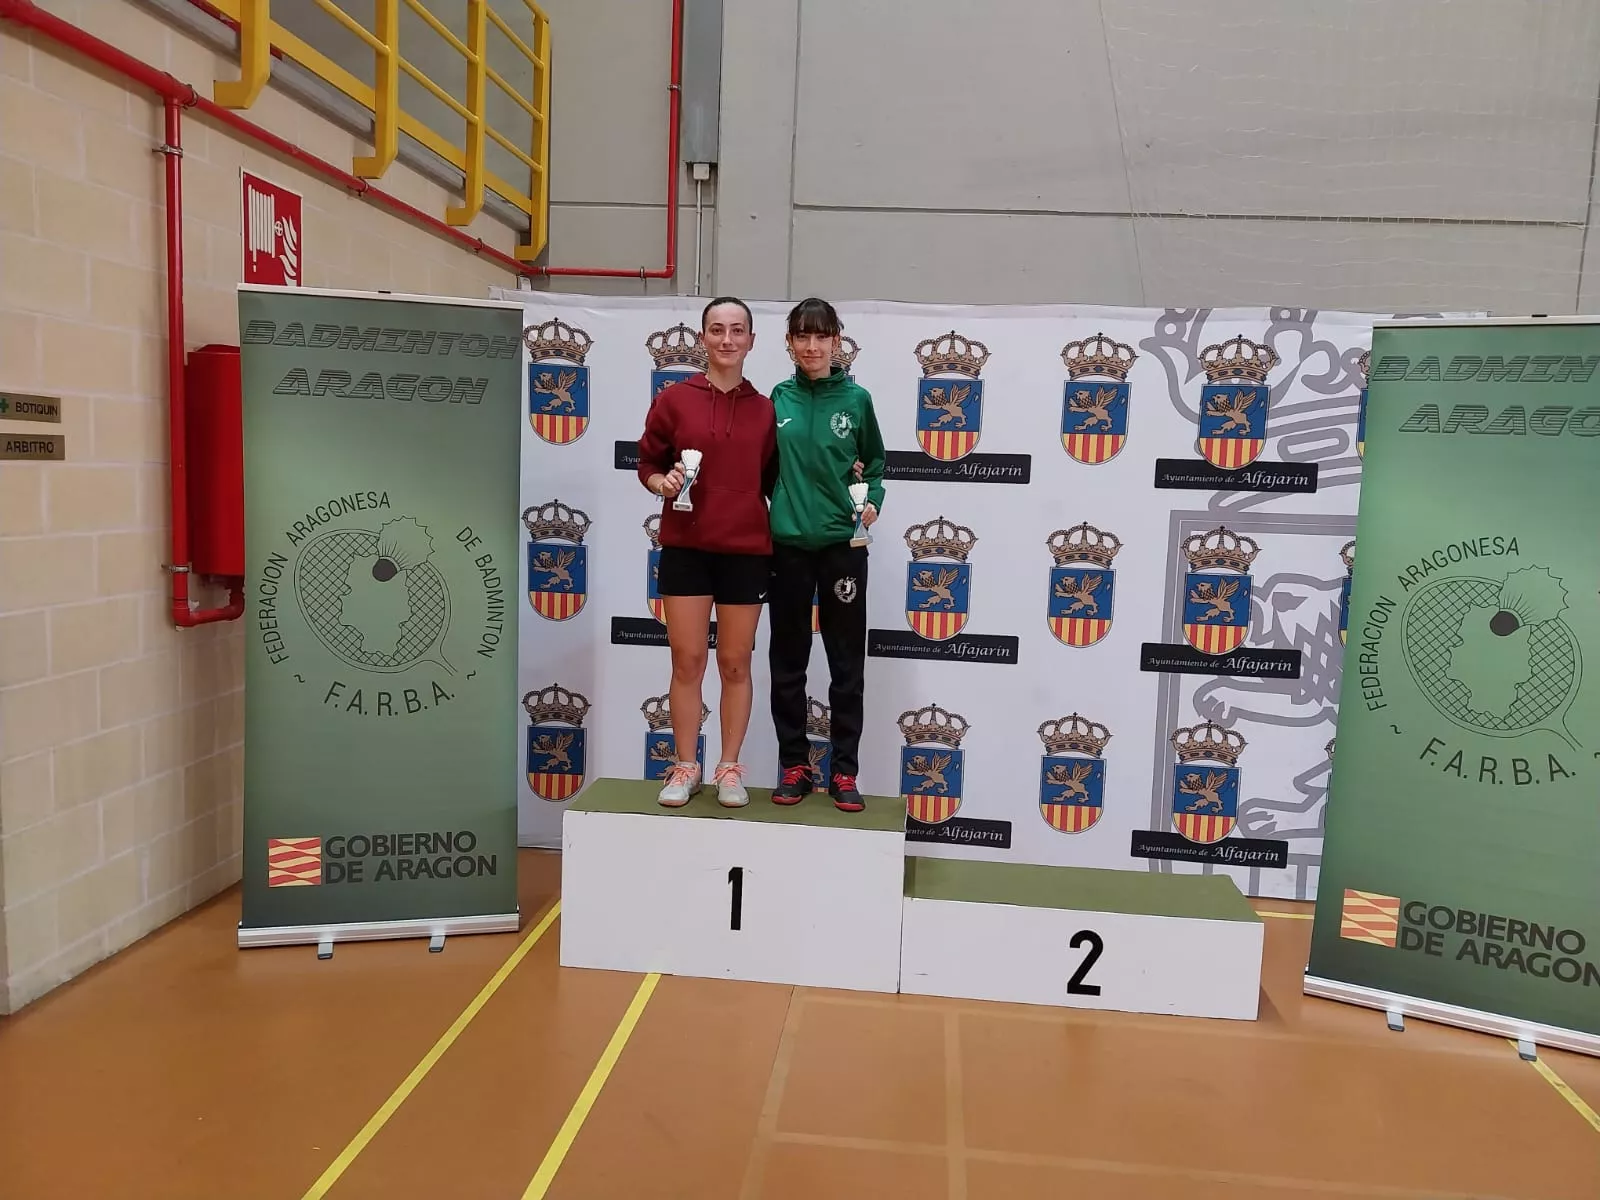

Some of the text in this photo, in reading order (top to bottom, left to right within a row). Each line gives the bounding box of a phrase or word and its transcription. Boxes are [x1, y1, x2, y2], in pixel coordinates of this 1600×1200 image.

[242, 319, 520, 359] BADMINTON
[273, 367, 489, 404] ARAGON
[15, 401, 58, 416] BOTIQUIN
[6, 440, 55, 453] ARBITRO
[943, 467, 953, 475] de
[1161, 473, 1224, 485] Ayuntamiento
[1224, 474, 1235, 483] de
[258, 491, 505, 665] FEDERACION ARAGONESA DE BADMINTON
[617, 629, 669, 640] Ayuntamient
[1358, 535, 1520, 713] FEDERACION ARAGONESA
[874, 642, 931, 653] Ayuntamiento
[932, 645, 942, 653] de
[1147, 656, 1208, 668] Ayuntamiento
[1209, 659, 1220, 668] de
[325, 831, 477, 859] GOBIERNO
[1138, 843, 1197, 855] Ayuntamiento
[1198, 846, 1209, 856] de
[325, 854, 497, 884] DE ARAGON
[727, 866, 745, 931] 1
[1400, 926, 1445, 957] DE
[1403, 901, 1586, 955] GOBIERNO
[1066, 929, 1104, 996] 2
